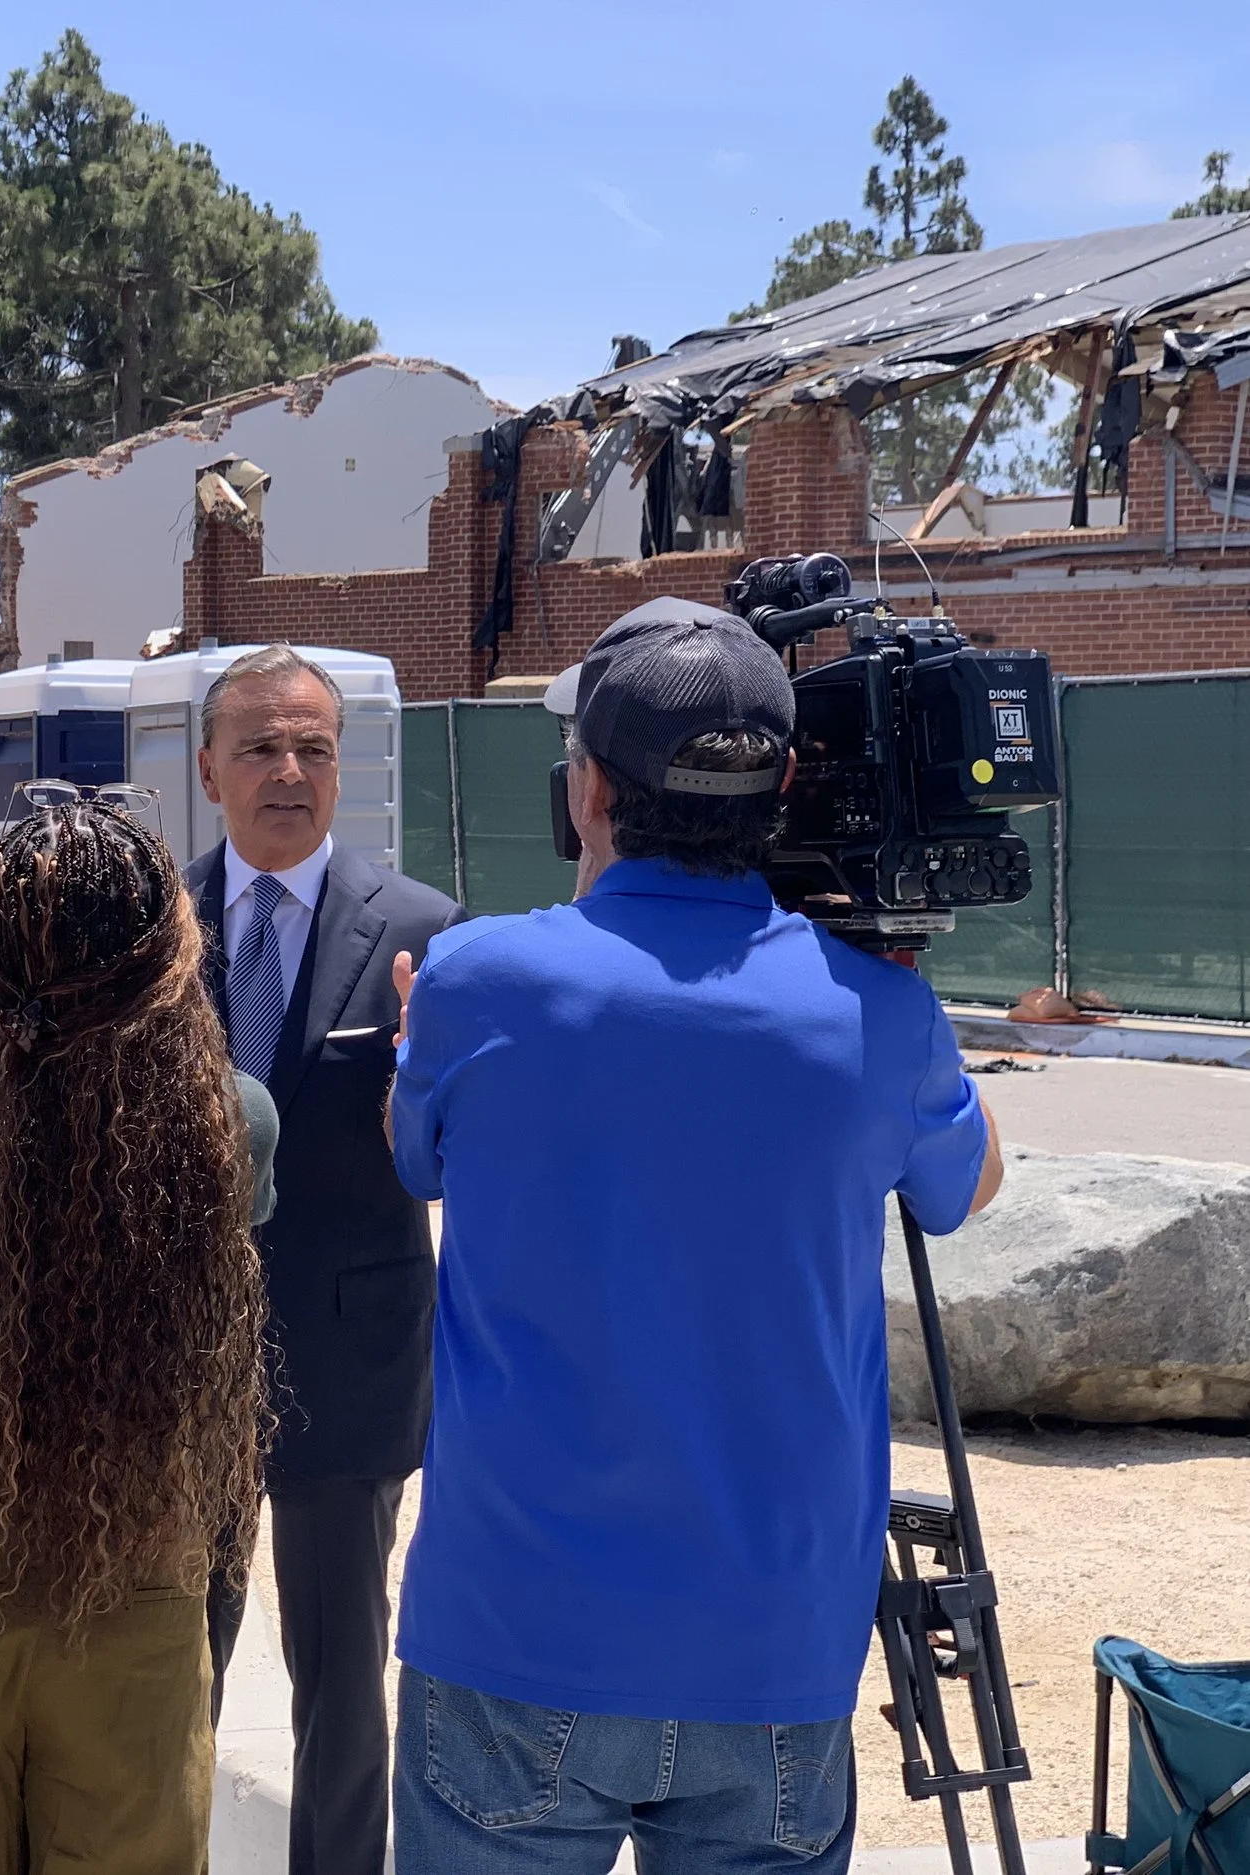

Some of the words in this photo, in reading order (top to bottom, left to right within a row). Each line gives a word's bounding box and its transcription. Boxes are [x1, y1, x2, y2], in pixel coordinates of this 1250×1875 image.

[988, 689, 1028, 700] DIONIC
[1002, 713, 1019, 727] XT
[994, 746, 1034, 755] ANTON
[994, 754, 1034, 762] BAUER
